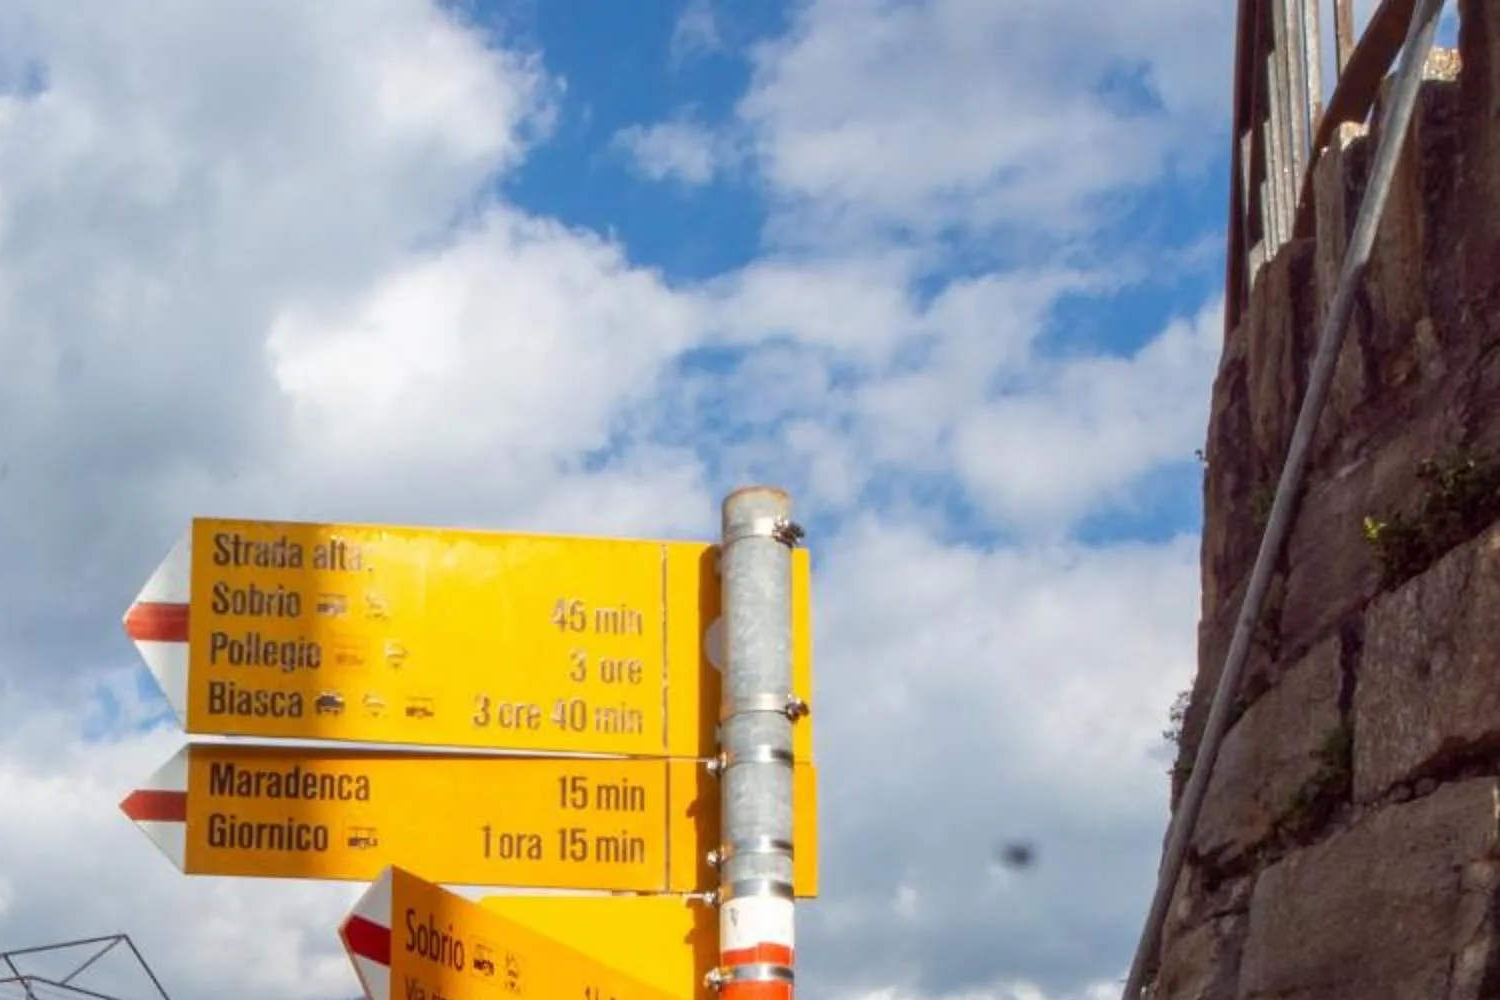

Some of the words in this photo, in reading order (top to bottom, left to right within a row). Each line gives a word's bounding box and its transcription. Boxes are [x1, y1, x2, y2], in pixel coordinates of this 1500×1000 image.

[212, 533, 304, 569] Strada
[211, 580, 302, 619] Sobrio
[553, 597, 587, 633] 45
[595, 604, 643, 636] min
[210, 631, 322, 673] Pollegio
[569, 648, 588, 683] 3
[600, 659, 643, 685] ore
[208, 681, 304, 718] Biasca
[473, 693, 491, 728] 3
[499, 702, 542, 731] ore
[553, 698, 588, 733] 40
[595, 702, 643, 736] min
[209, 762, 371, 801] Maradenca
[558, 775, 589, 811] 15
[596, 777, 646, 813] min
[207, 812, 330, 852] Giornico
[481, 824, 492, 860] 1
[499, 832, 543, 861] ora
[558, 827, 589, 863] 15
[596, 829, 646, 864] min
[406, 908, 466, 973] Sobrio
